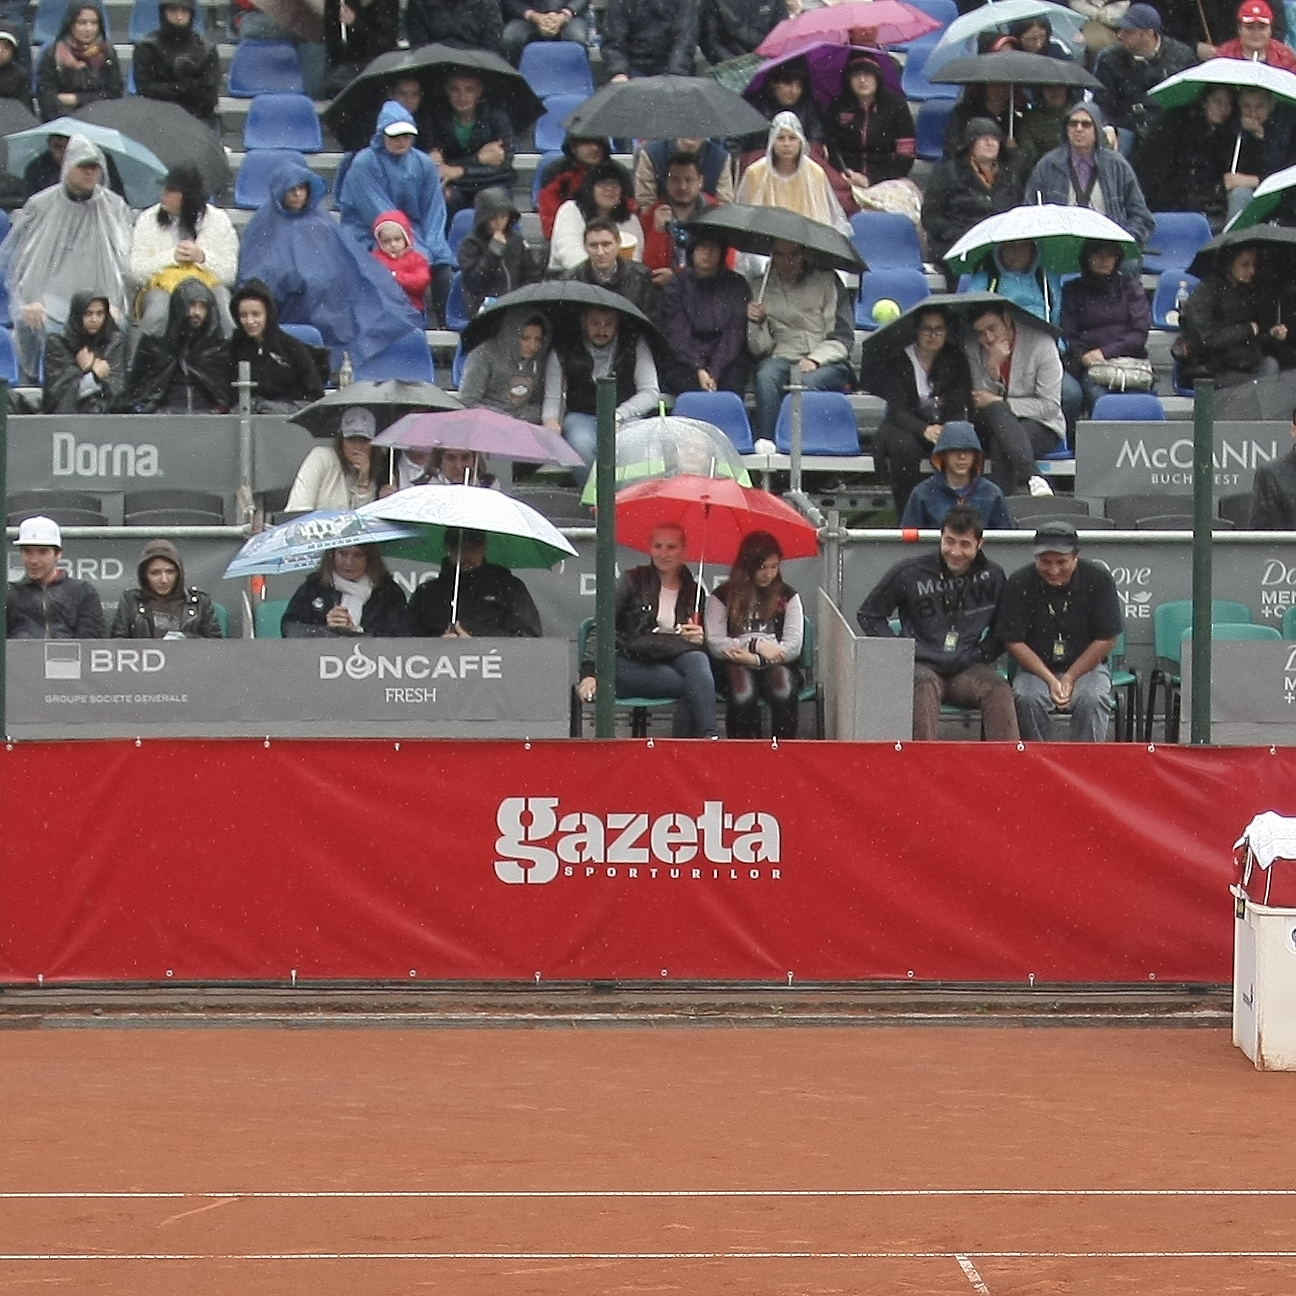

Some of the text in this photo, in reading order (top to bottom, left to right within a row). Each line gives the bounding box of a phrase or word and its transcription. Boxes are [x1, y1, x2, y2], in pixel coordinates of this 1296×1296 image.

[52, 432, 160, 478] Dorna
[1116, 440, 1278, 469] McCNN
[1151, 474, 1239, 485] BUCHEST
[90, 650, 167, 673] BRD
[385, 688, 437, 702] FRESH
[494, 796, 782, 884] gazeta
[564, 866, 782, 880] SPORTURILOR
